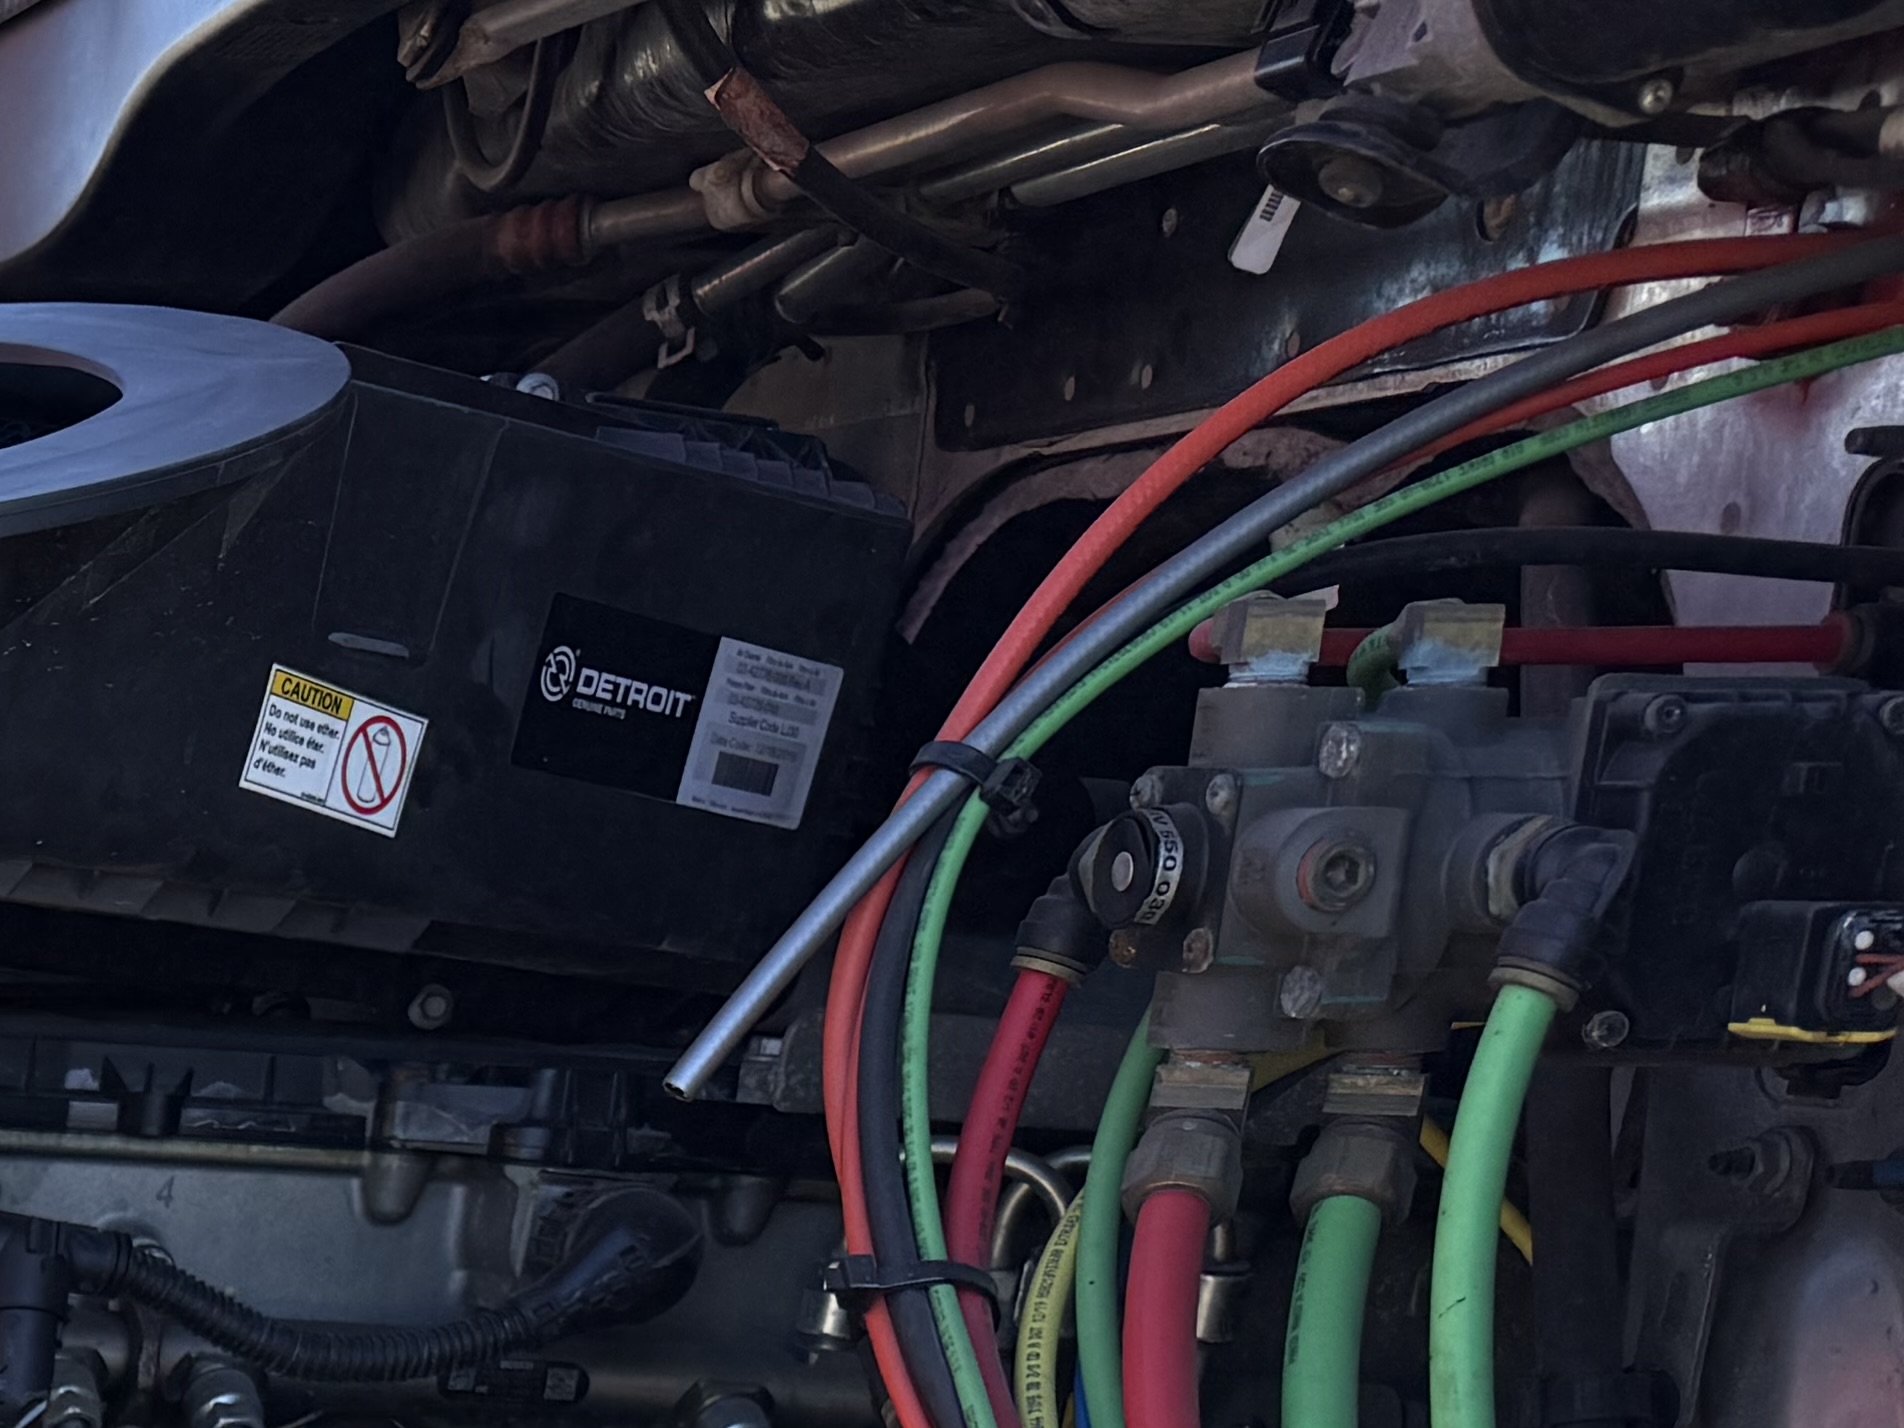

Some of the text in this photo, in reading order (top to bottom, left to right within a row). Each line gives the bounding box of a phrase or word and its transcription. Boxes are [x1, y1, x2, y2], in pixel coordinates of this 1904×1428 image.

[281, 678, 342, 714] CAUTION
[575, 667, 692, 719] DETROIT
[264, 722, 276, 736] No
[269, 705, 281, 718] Do
[284, 711, 298, 723] not
[300, 718, 315, 731] use
